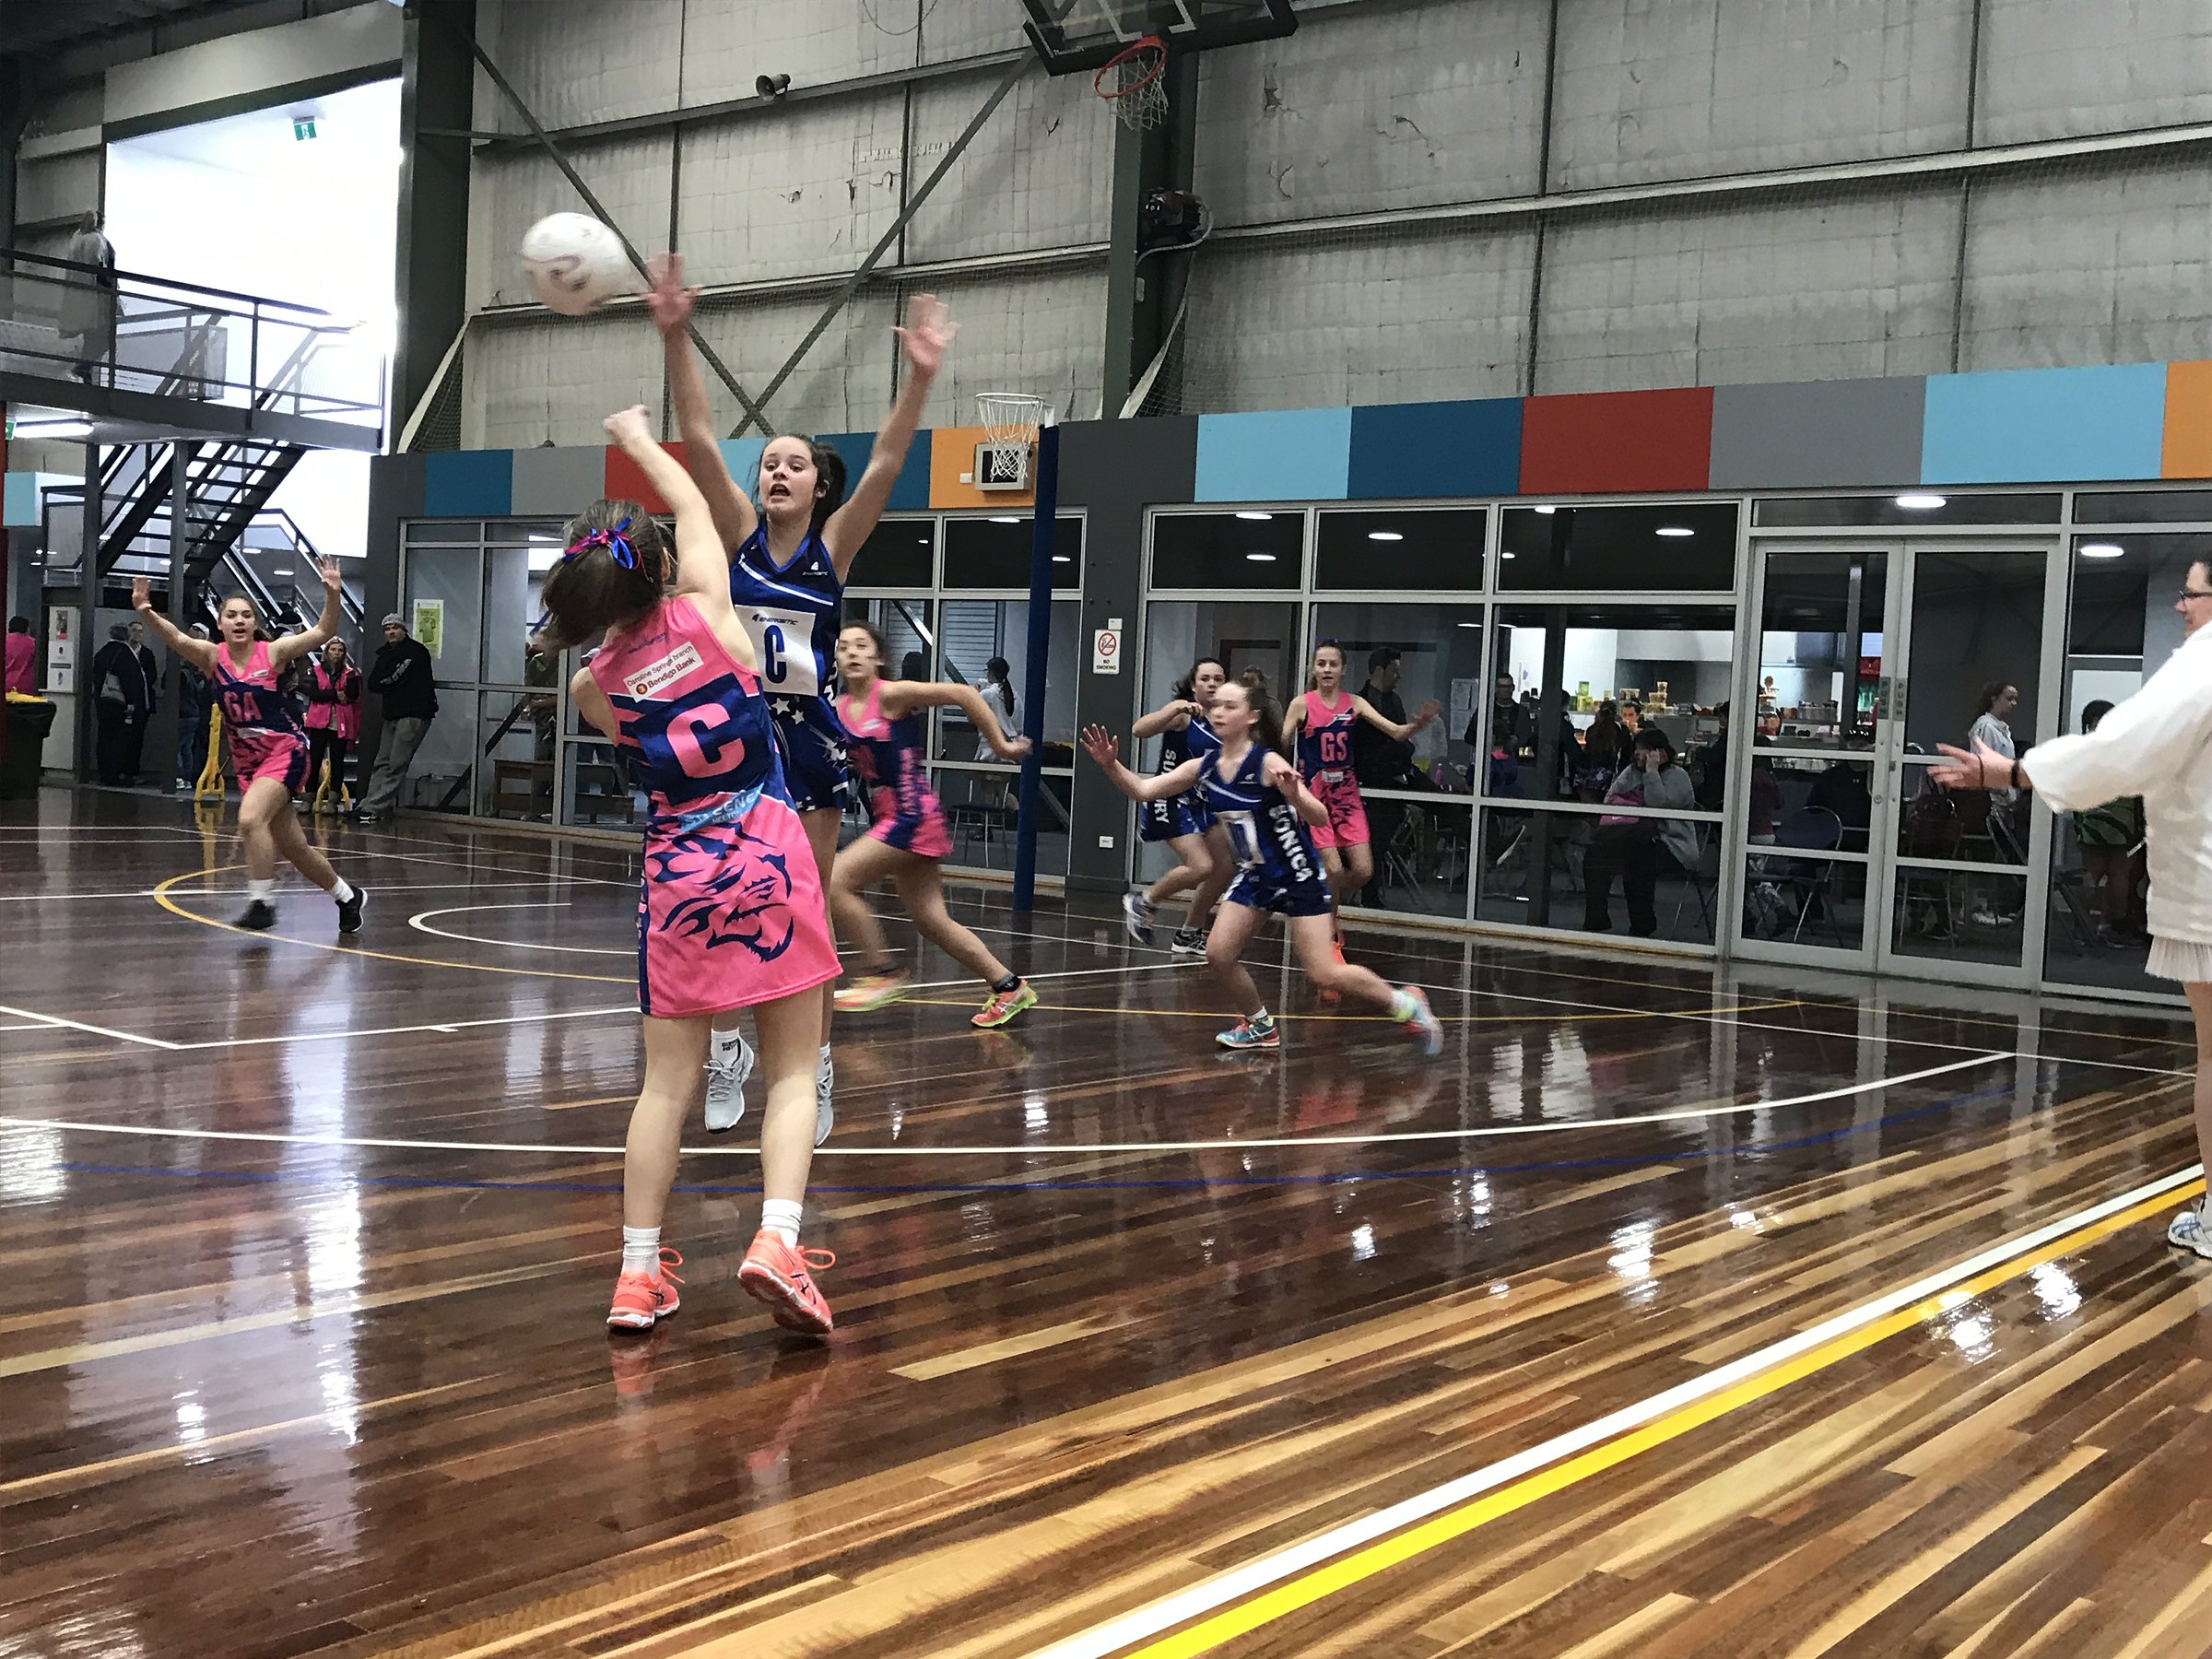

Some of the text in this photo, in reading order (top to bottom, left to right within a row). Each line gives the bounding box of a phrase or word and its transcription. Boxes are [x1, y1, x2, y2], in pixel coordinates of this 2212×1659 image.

[759, 616, 799, 626] ENERGETIC
[627, 645, 693, 687] Caroline Springs branch
[764, 624, 787, 684] C
[647, 656, 696, 688] Bendigo Bank
[223, 690, 263, 723] GA
[1896, 682, 1904, 716] PUSH
[666, 702, 745, 778] C
[1320, 731, 1348, 762] GS
